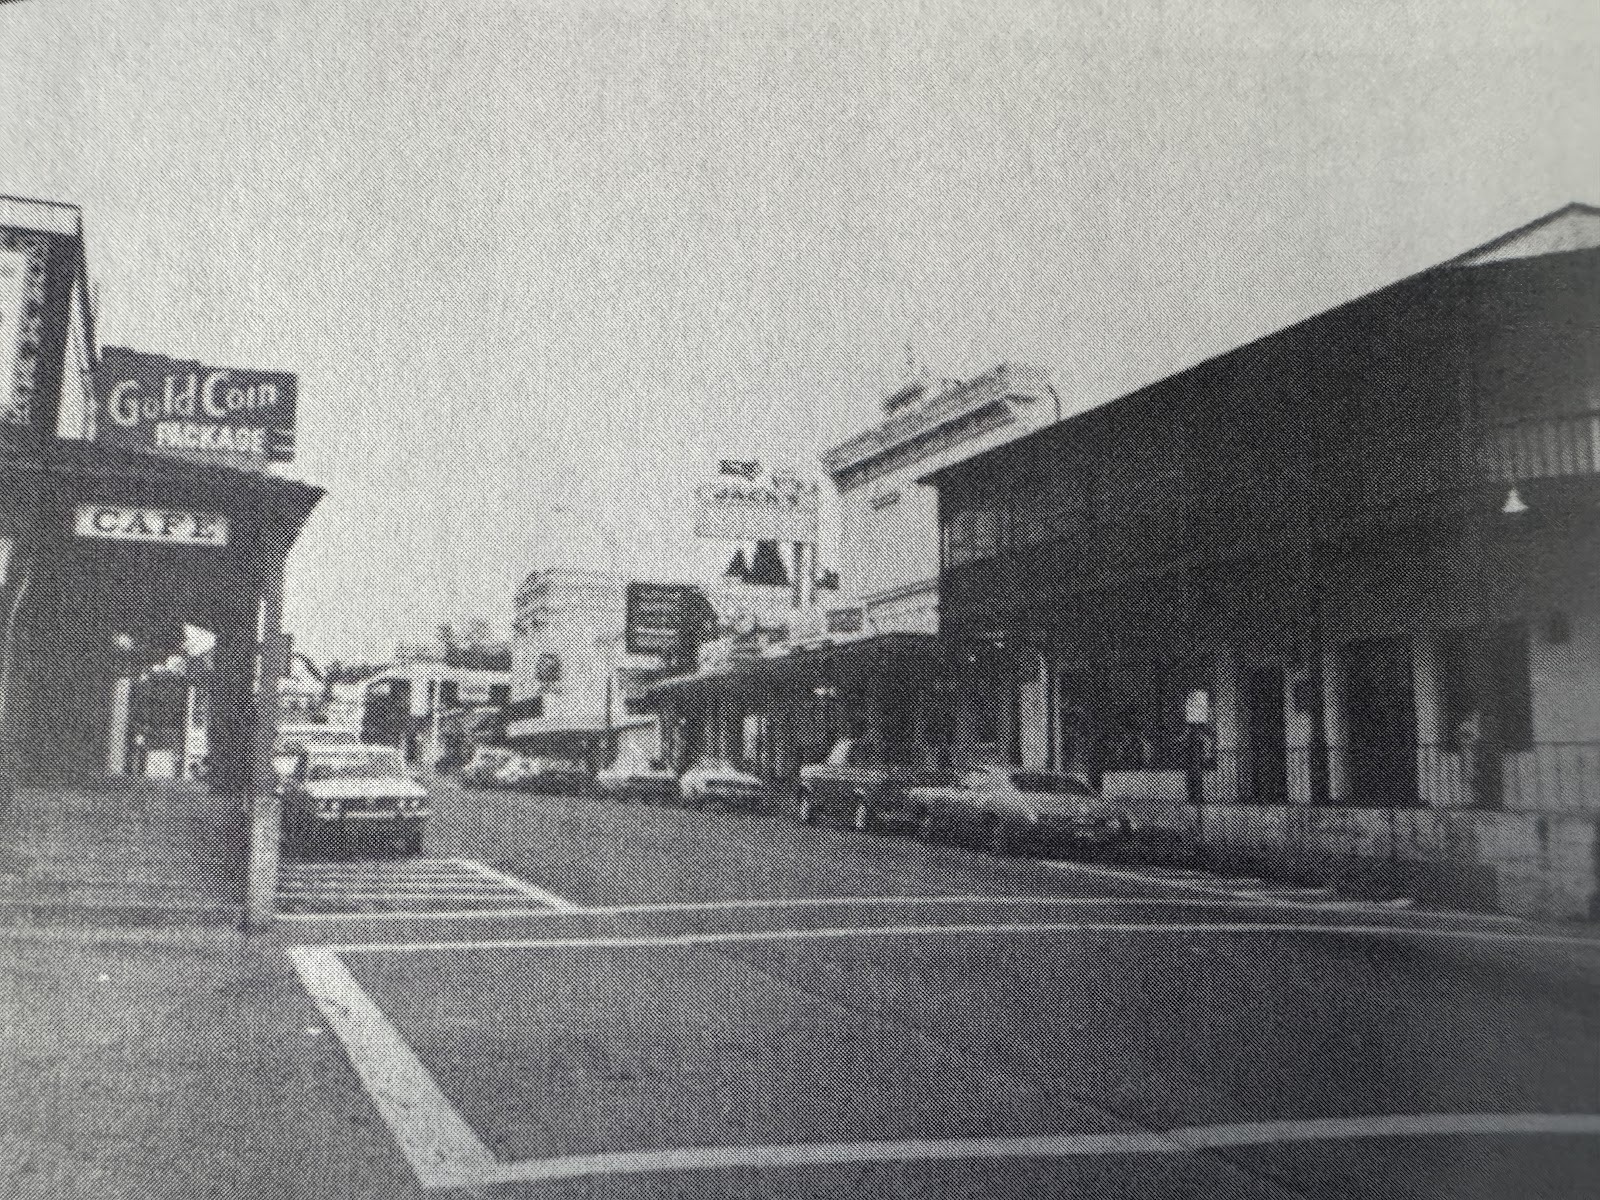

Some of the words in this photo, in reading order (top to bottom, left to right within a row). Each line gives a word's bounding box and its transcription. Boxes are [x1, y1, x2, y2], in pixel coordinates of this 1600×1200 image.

[108, 373, 197, 426] Gold
[202, 371, 278, 418] Coin
[156, 421, 266, 454] PACKAGE
